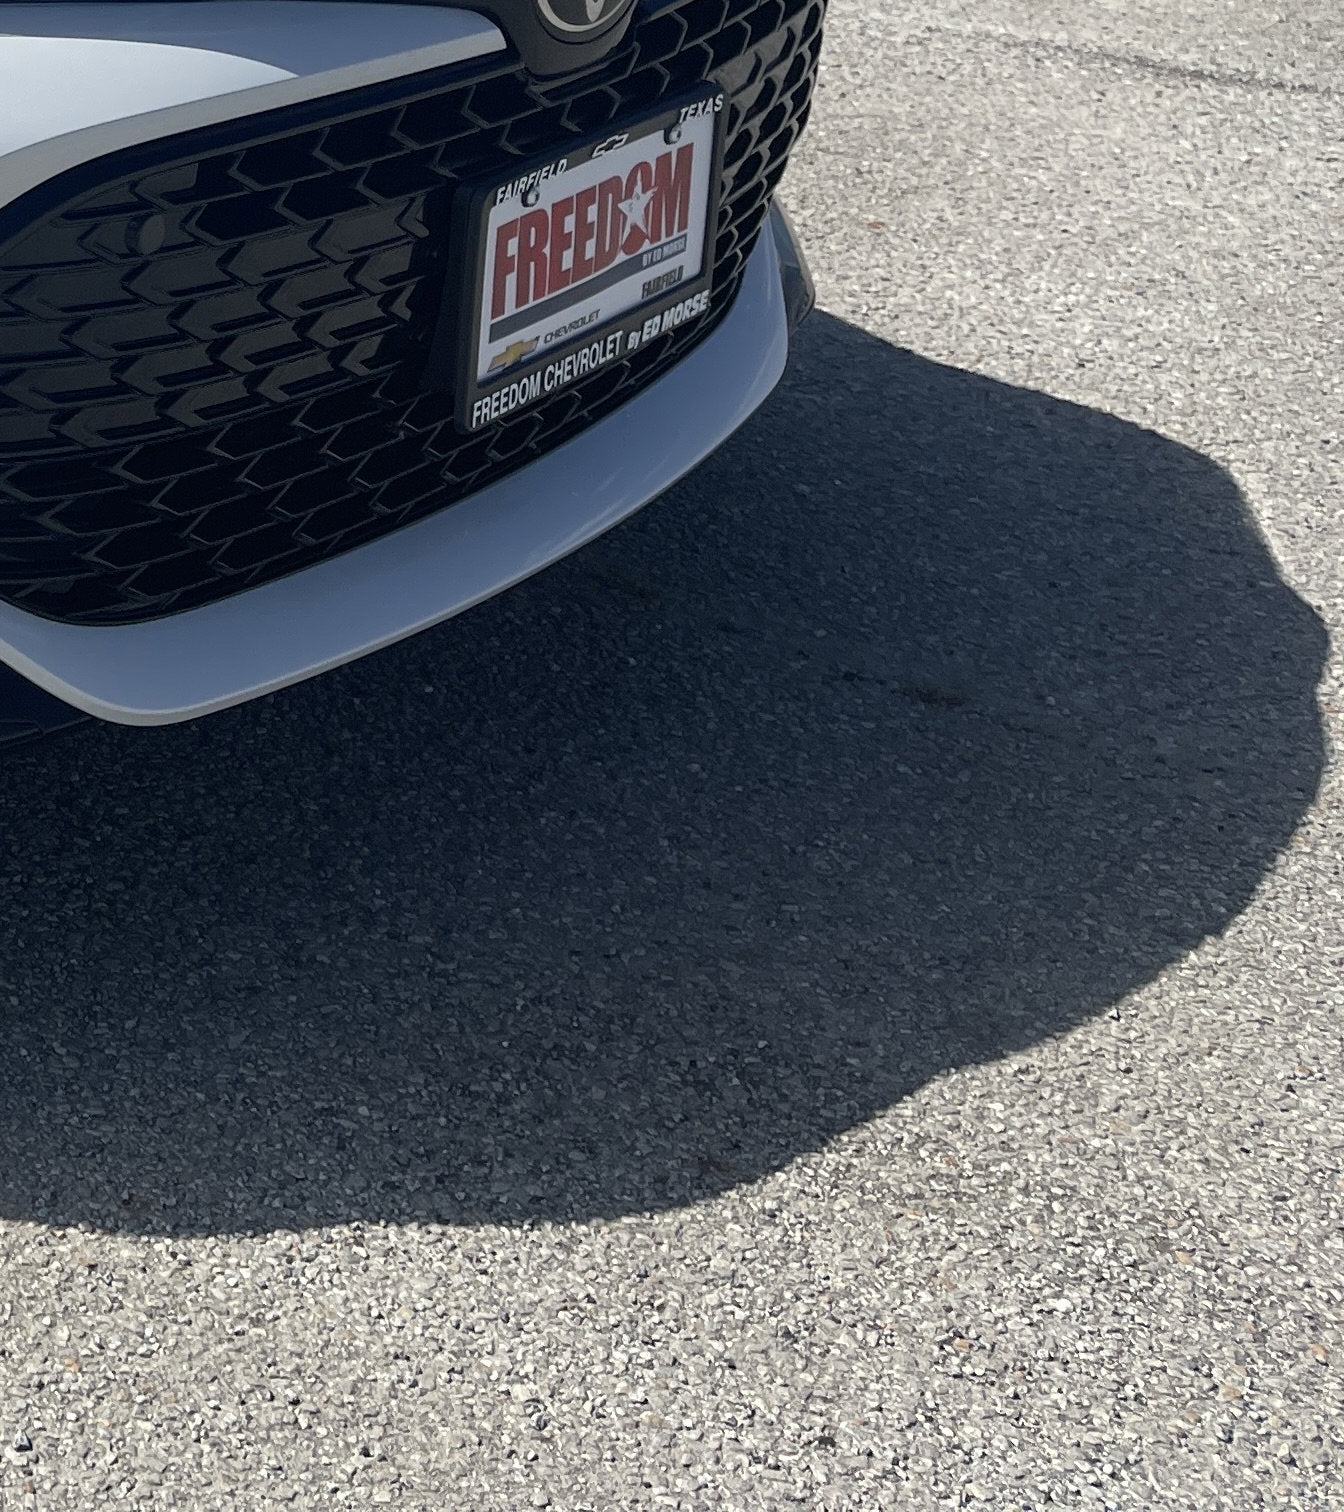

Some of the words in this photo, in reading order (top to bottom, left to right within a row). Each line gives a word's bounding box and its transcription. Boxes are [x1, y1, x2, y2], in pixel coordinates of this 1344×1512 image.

[496, 158, 568, 205] FAIRFIELD
[679, 94, 724, 123] TEXAS
[491, 143, 694, 320] FREEDOM
[472, 371, 541, 428] FREEDOM
[544, 330, 624, 392] CHEVROLET
[642, 316, 663, 342] ED
[661, 289, 710, 332] MORSE
[544, 309, 601, 344] CHEVROLET
